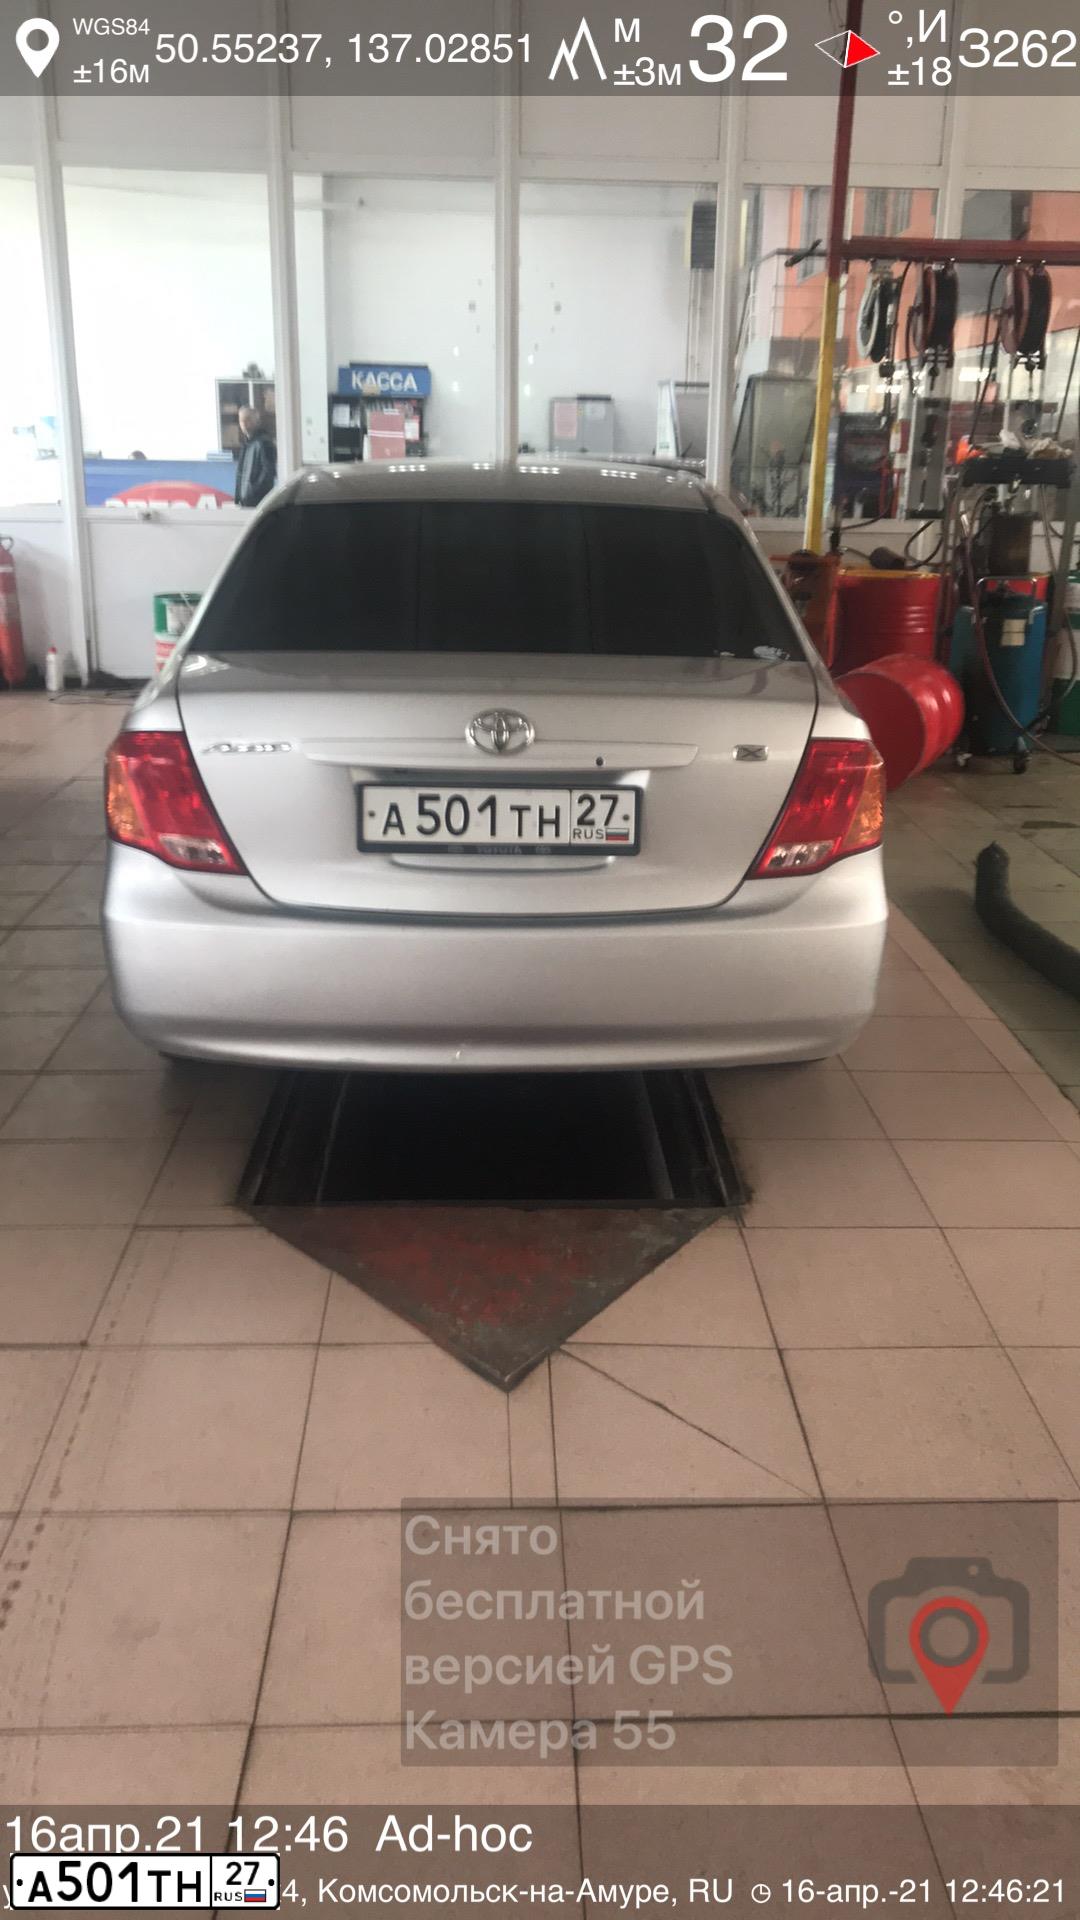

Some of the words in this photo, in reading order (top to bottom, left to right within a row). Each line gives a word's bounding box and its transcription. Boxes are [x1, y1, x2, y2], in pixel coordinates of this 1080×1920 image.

[351, 370, 418, 392] КАССА
[576, 793, 619, 826] 27
[572, 828, 604, 840] RUS
